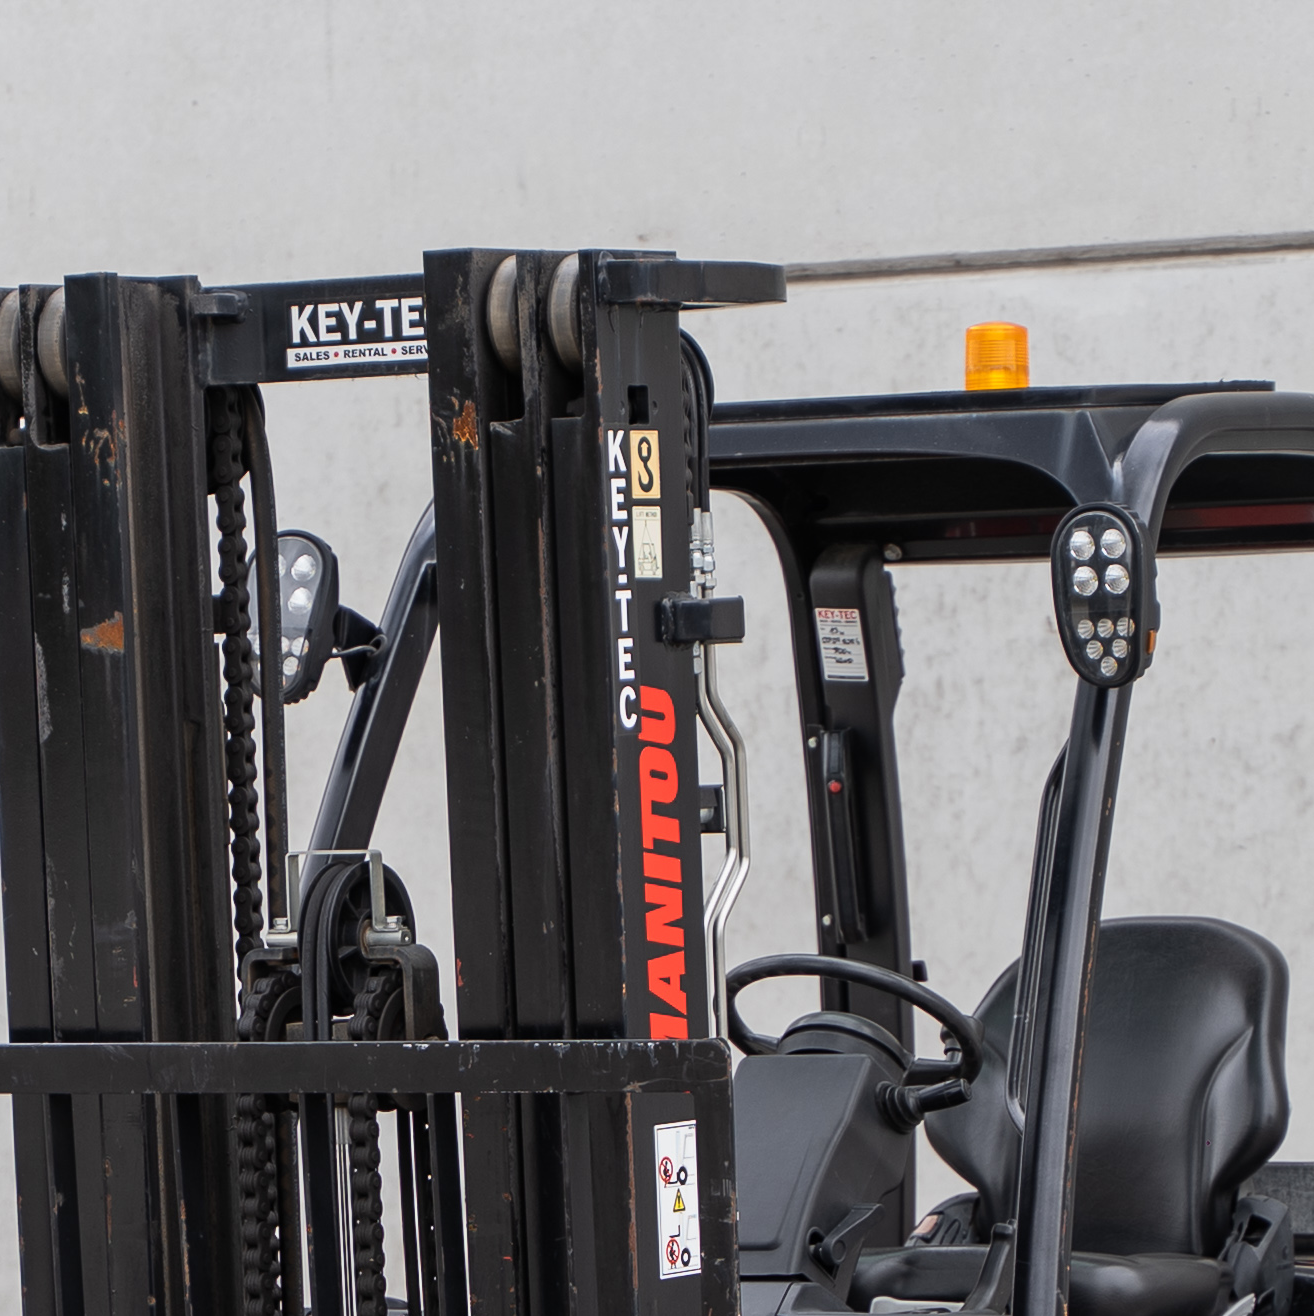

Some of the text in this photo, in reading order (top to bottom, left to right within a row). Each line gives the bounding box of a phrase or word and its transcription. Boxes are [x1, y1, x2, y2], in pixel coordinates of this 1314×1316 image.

[290, 297, 428, 344] KEY-TE
[295, 351, 330, 362] SALES
[343, 348, 388, 359] RENTAL
[607, 430, 639, 728] KEY-TEC
